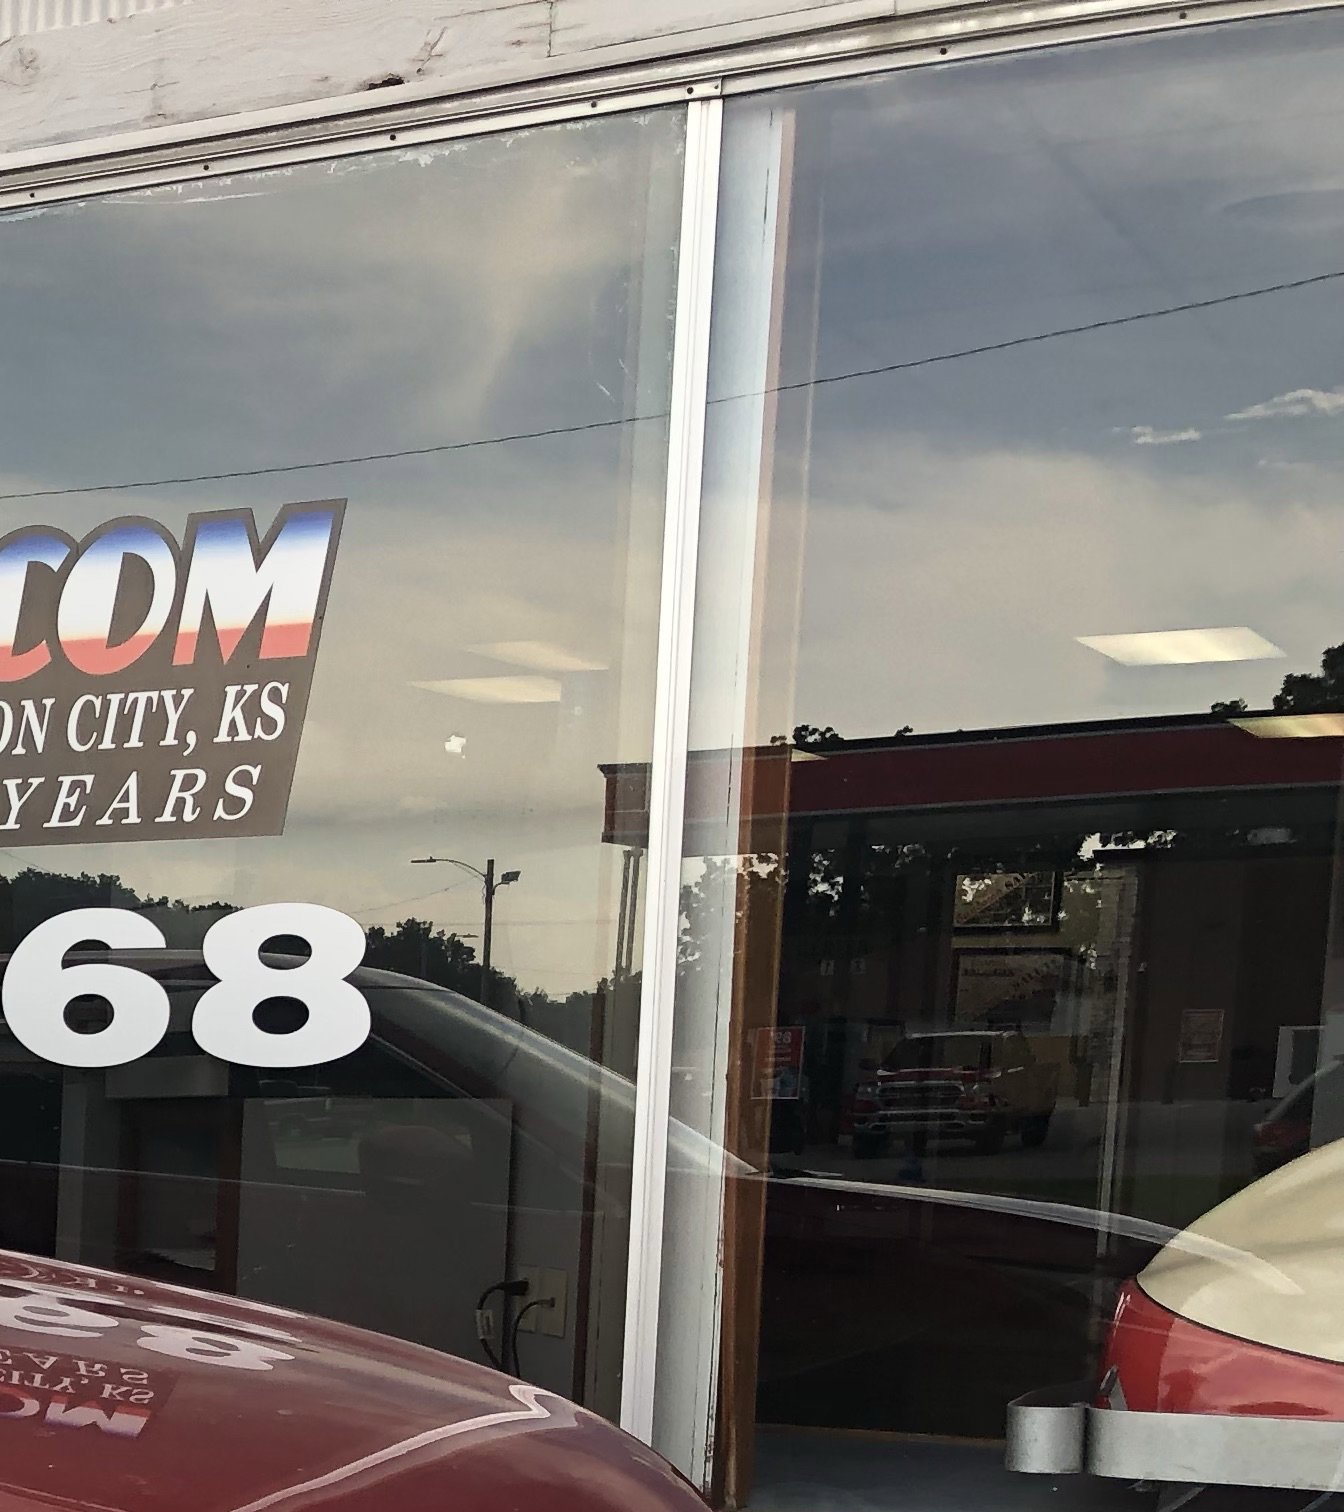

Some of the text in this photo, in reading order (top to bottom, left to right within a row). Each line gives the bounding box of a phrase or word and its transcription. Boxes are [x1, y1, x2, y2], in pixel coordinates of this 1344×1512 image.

[66, 687, 198, 752] CITY,
[214, 681, 289, 742] KS
[0, 763, 263, 831] YEARS
